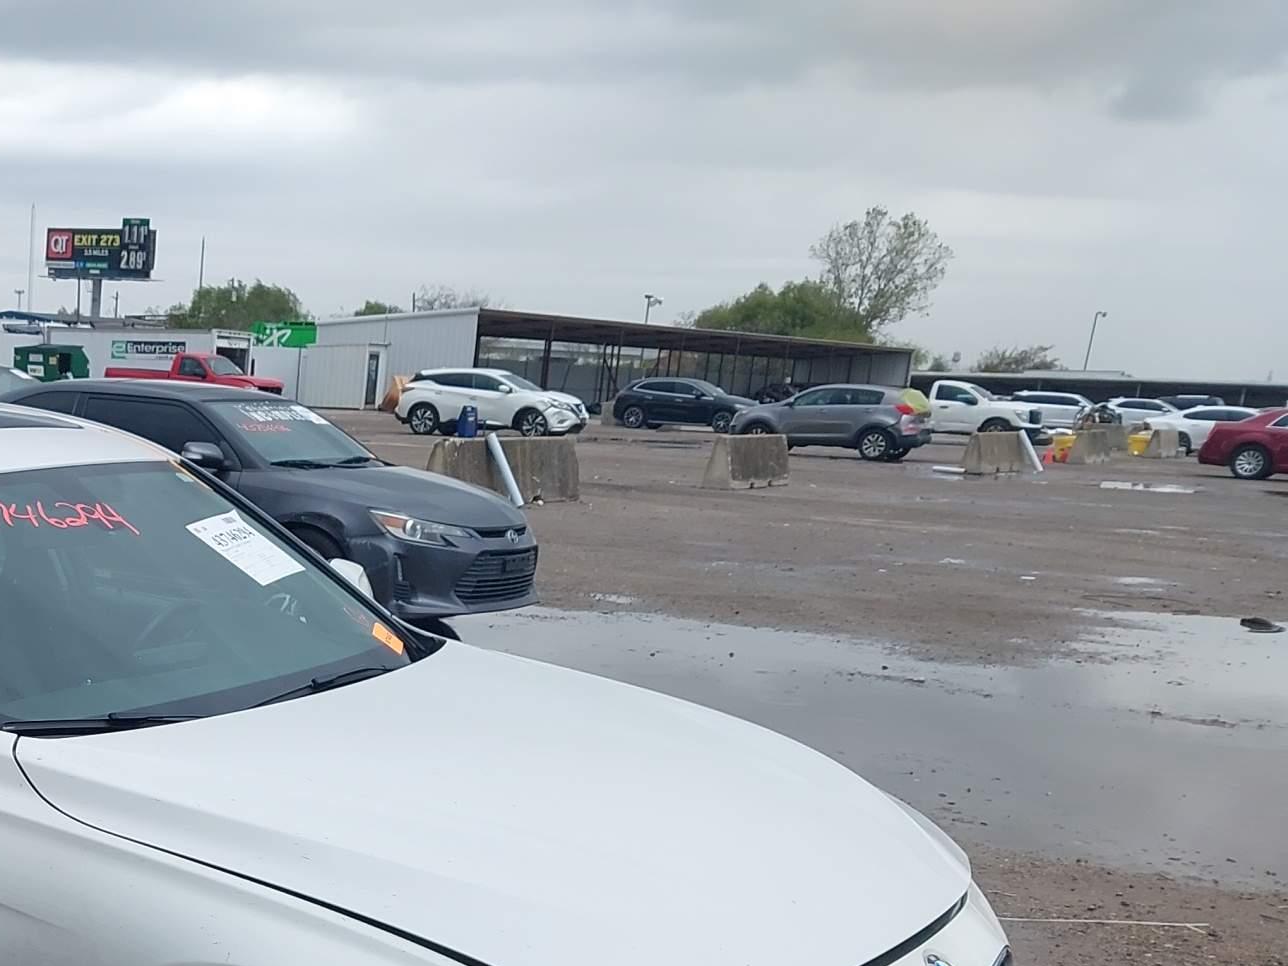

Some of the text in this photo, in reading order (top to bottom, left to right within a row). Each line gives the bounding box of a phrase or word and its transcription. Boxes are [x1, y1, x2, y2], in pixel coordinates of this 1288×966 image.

[51, 235, 68, 253] QT
[74, 234, 121, 246] EXIT 273
[127, 341, 185, 354] Enterprise
